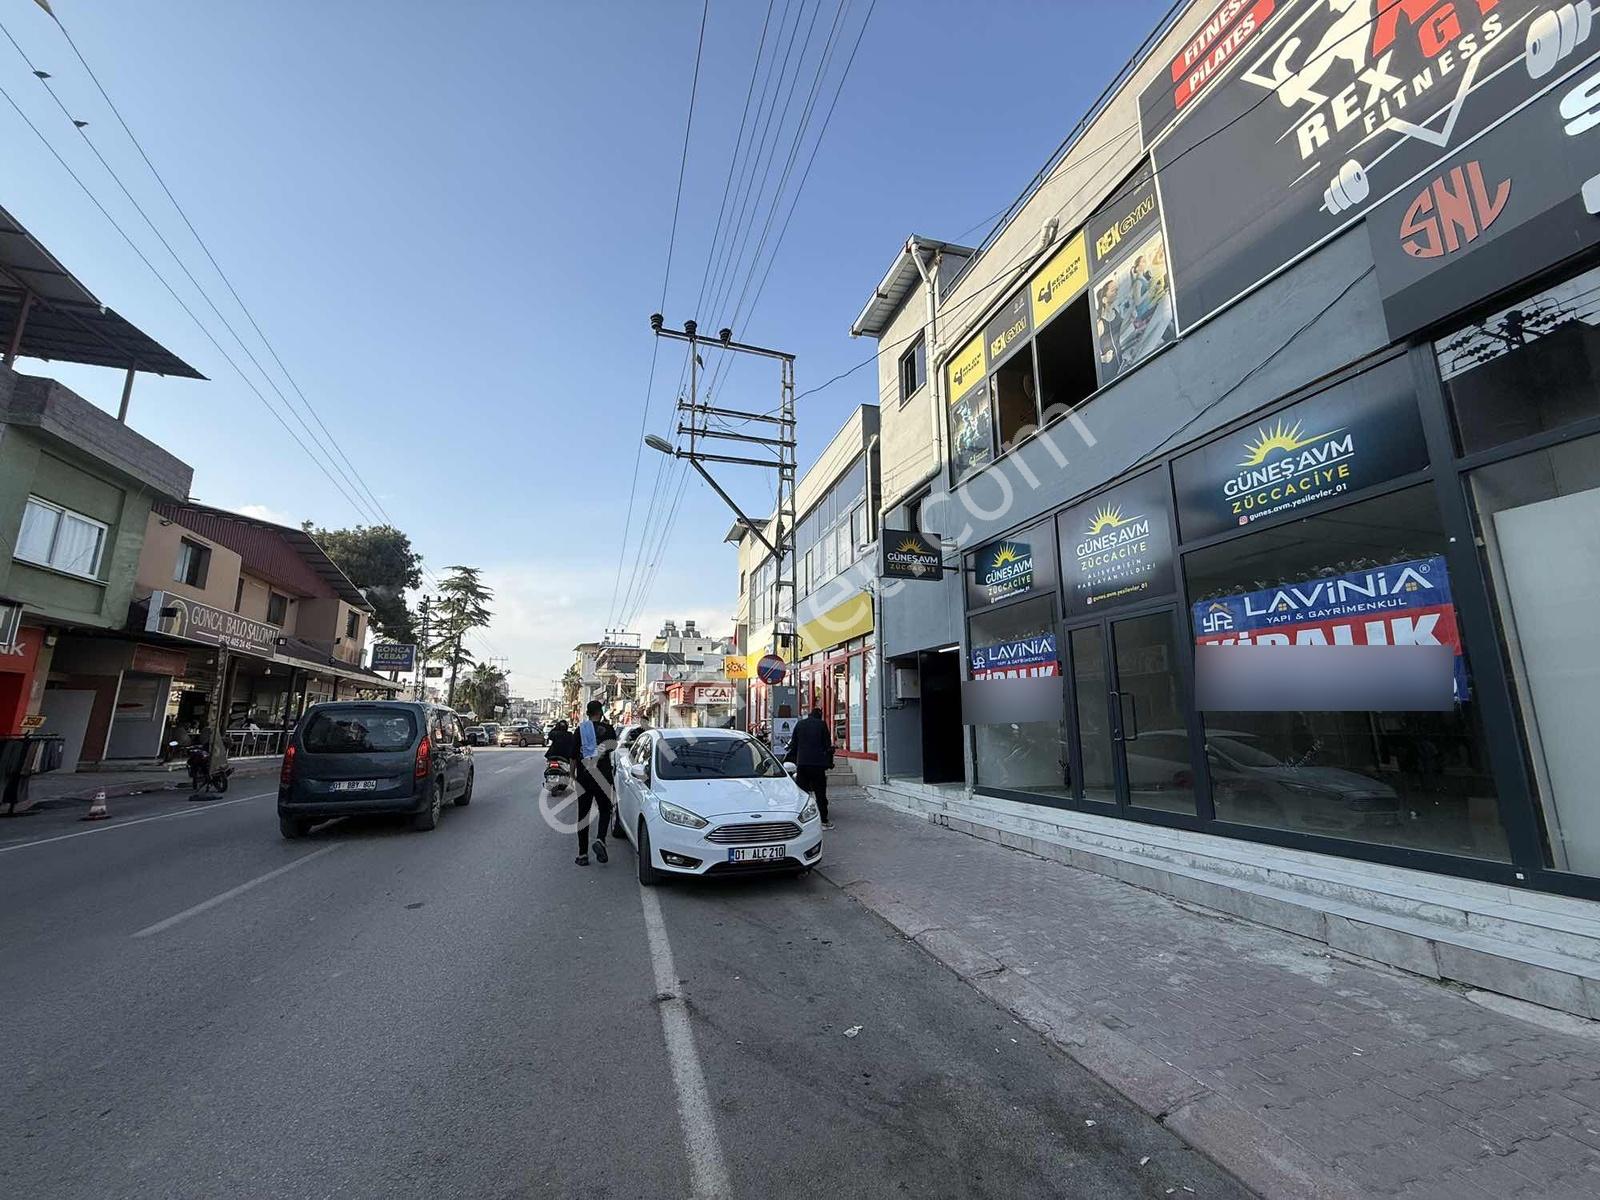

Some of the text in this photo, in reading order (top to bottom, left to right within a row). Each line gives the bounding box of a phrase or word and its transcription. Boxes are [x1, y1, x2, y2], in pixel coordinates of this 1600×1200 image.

[1184, 0, 1248, 66] FİTNES
[1296, 50, 1403, 160] REX
[1399, 160, 1512, 259] SNL
[1223, 433, 1355, 497] GÜNEŞ AVM
[1232, 464, 1351, 515] ZÜCCACİYE
[1249, 483, 1348, 522] gunes.avm.yesilevler_01
[1076, 519, 1149, 558] GÜNEŞ AVM
[918, 555, 938, 564] AVM
[1012, 557, 1033, 573] AVM
[1266, 598, 1408, 625] YAPI & GAYRİMENKUL
[735, 847, 784, 860] 01 ALC 210
